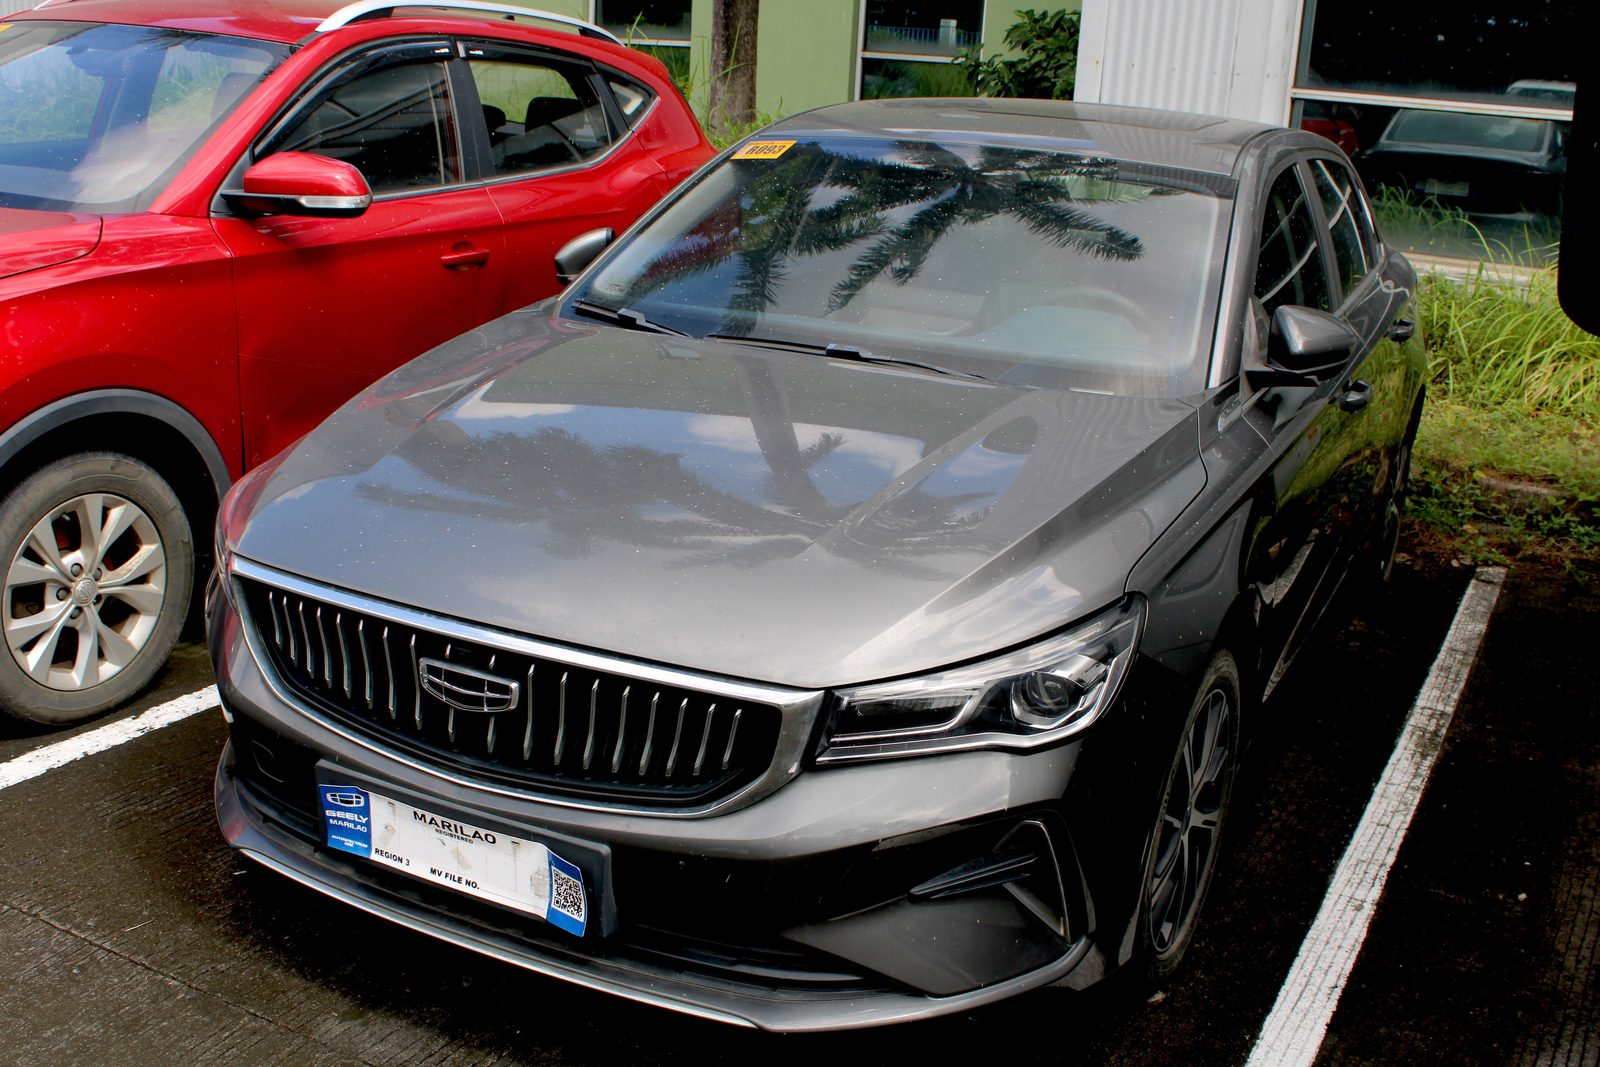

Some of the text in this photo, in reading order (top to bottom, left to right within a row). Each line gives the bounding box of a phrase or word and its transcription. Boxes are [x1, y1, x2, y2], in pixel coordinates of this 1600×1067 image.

[325, 810, 368, 824] GEELY
[329, 819, 367, 833] MARILAO
[413, 810, 497, 845] MARILAO
[434, 828, 474, 844] REGISTERED
[374, 847, 410, 866] REGION 3
[429, 867, 480, 890] MV FILE NO.
